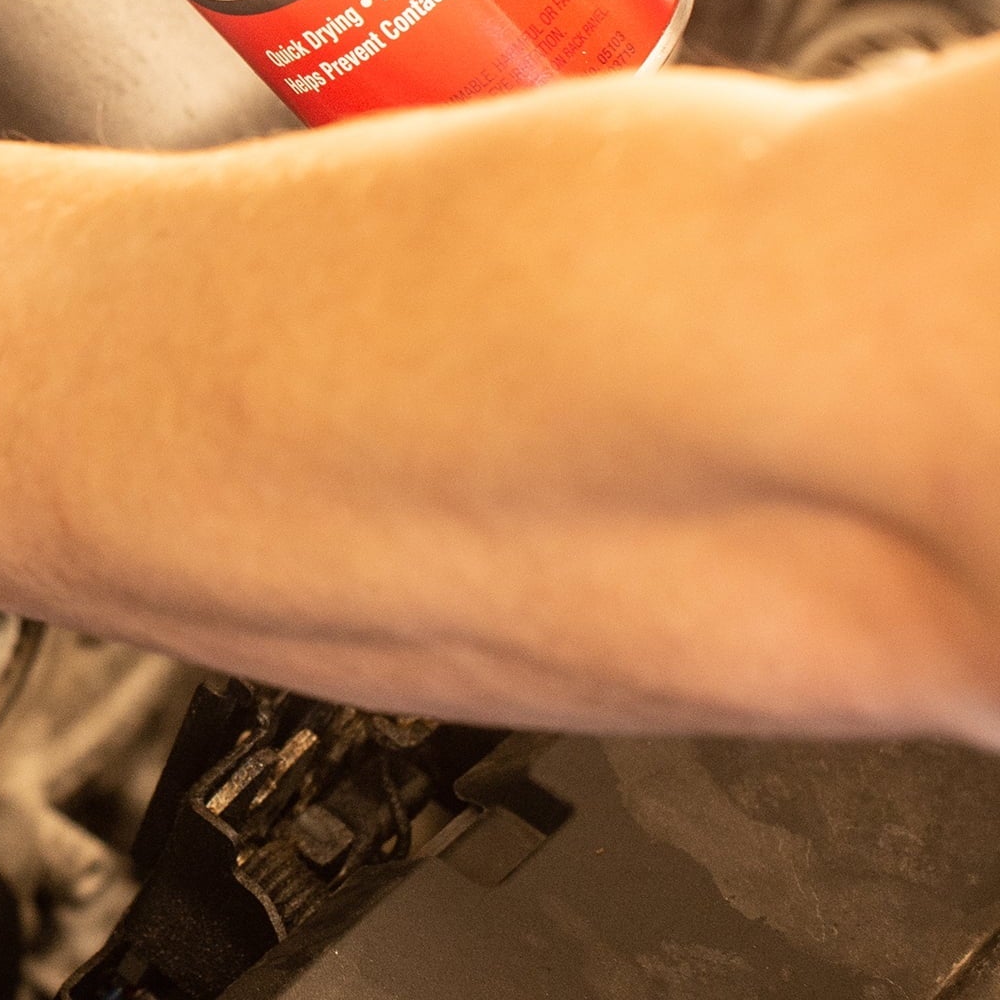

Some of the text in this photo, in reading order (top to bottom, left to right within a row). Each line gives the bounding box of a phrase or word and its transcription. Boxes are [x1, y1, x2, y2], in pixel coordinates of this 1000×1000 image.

[539, 6, 559, 26] OR
[582, 7, 609, 38] PANEL
[265, 39, 311, 68] Quick
[302, 6, 364, 50] Drying
[597, 30, 626, 65] 05103
[284, 69, 327, 95] Helps
[319, 31, 388, 81] Prevent
